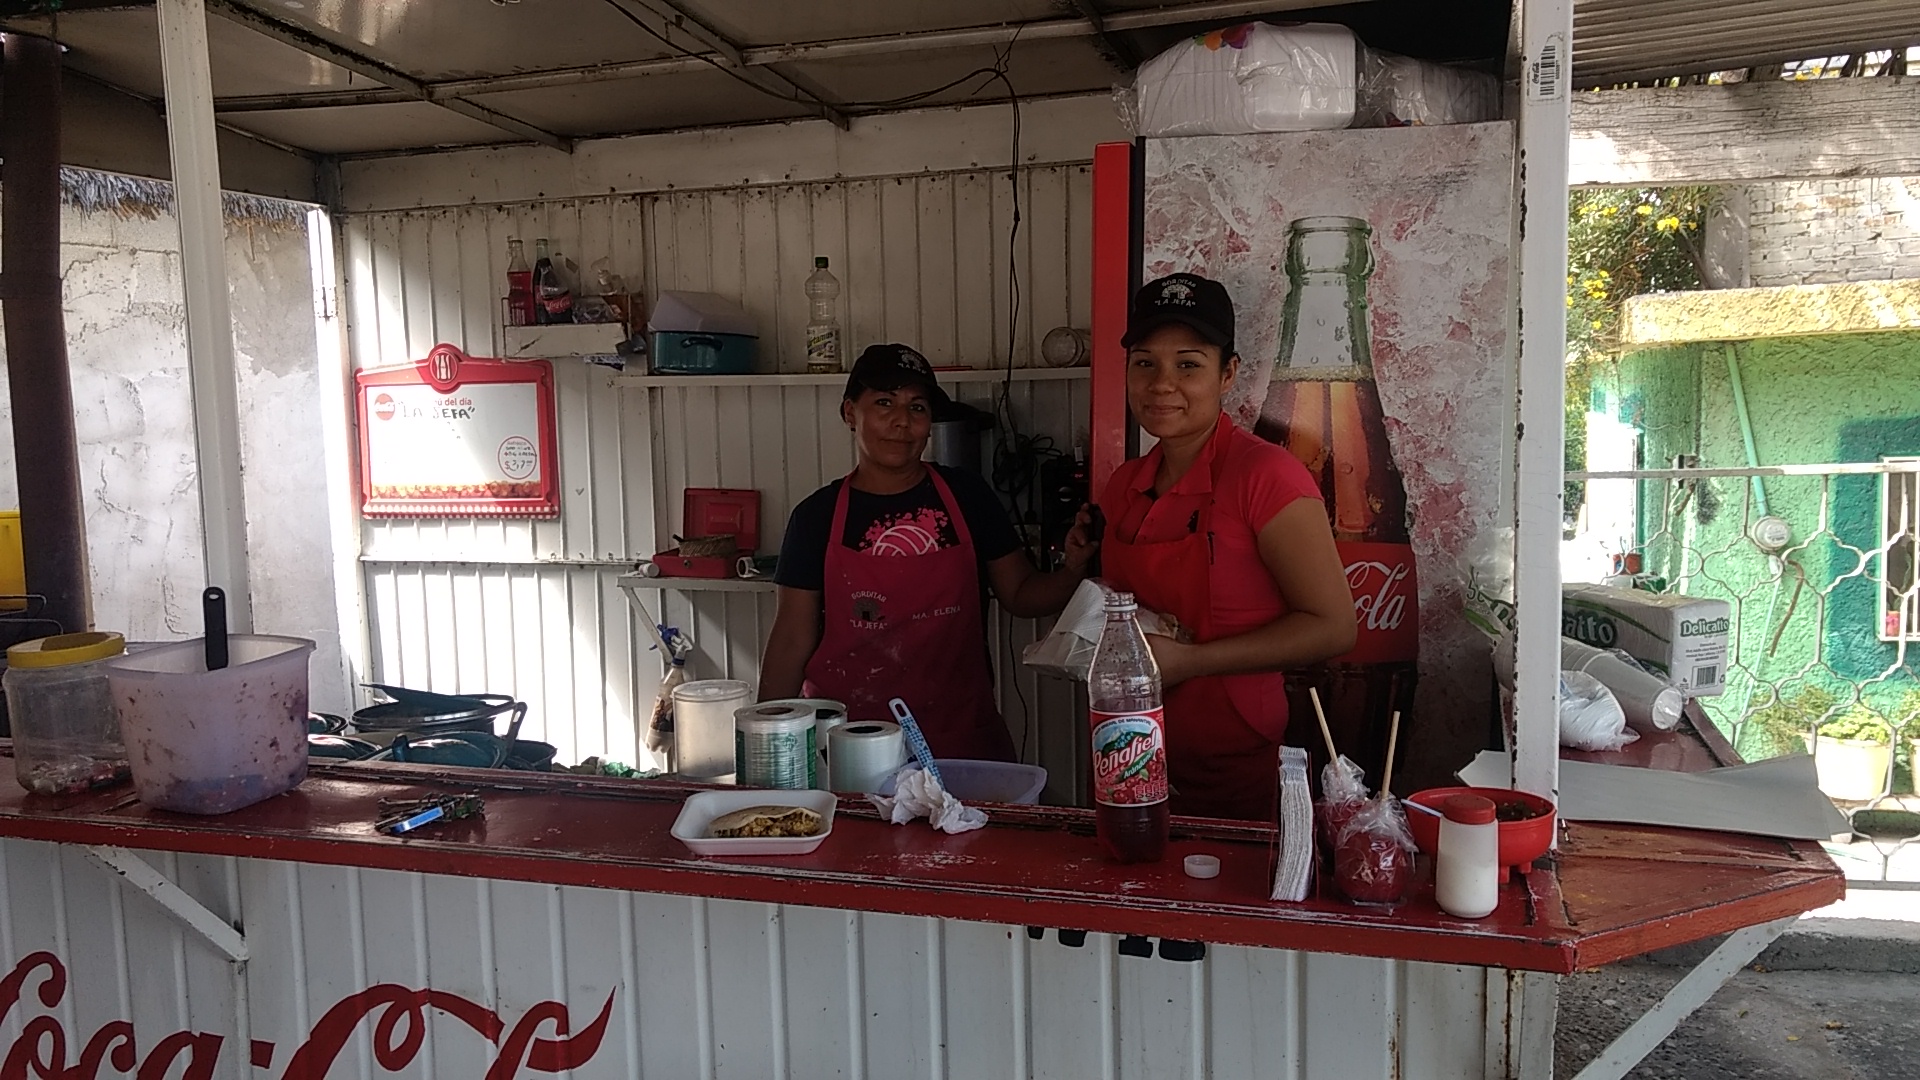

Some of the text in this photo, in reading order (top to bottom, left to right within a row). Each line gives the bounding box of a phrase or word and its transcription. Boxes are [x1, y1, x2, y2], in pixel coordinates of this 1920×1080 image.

[444, 397, 457, 406] del
[459, 397, 472, 406] día
[934, 605, 961, 617] ELENA
[1682, 617, 1729, 635] Delicatto
[1095, 727, 1157, 776] Peñafiel
